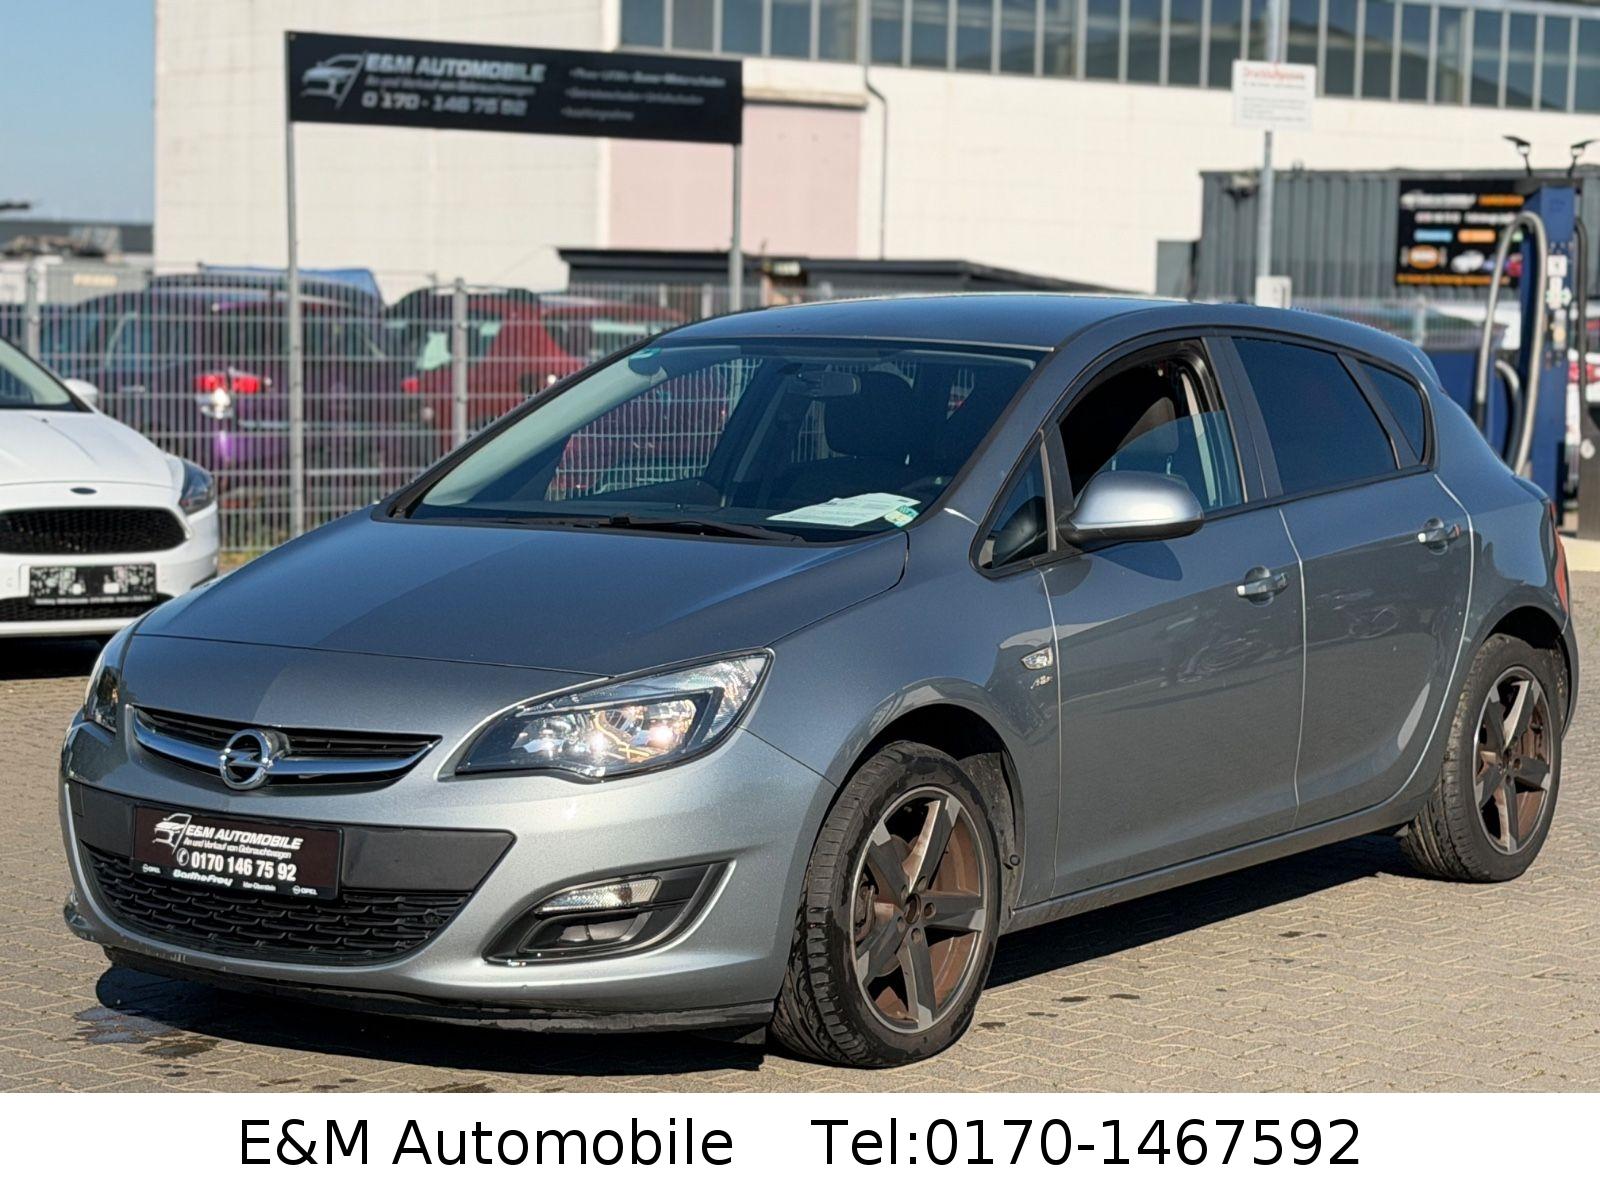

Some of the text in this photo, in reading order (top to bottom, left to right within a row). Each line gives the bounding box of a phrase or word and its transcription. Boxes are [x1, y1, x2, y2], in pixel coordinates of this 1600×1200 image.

[365, 53, 415, 74] E&M
[415, 56, 547, 83] AUTOMOBILE
[185, 825, 303, 850] E&M AUTOMOBILE
[191, 851, 297, 881] 0170 146 75 92
